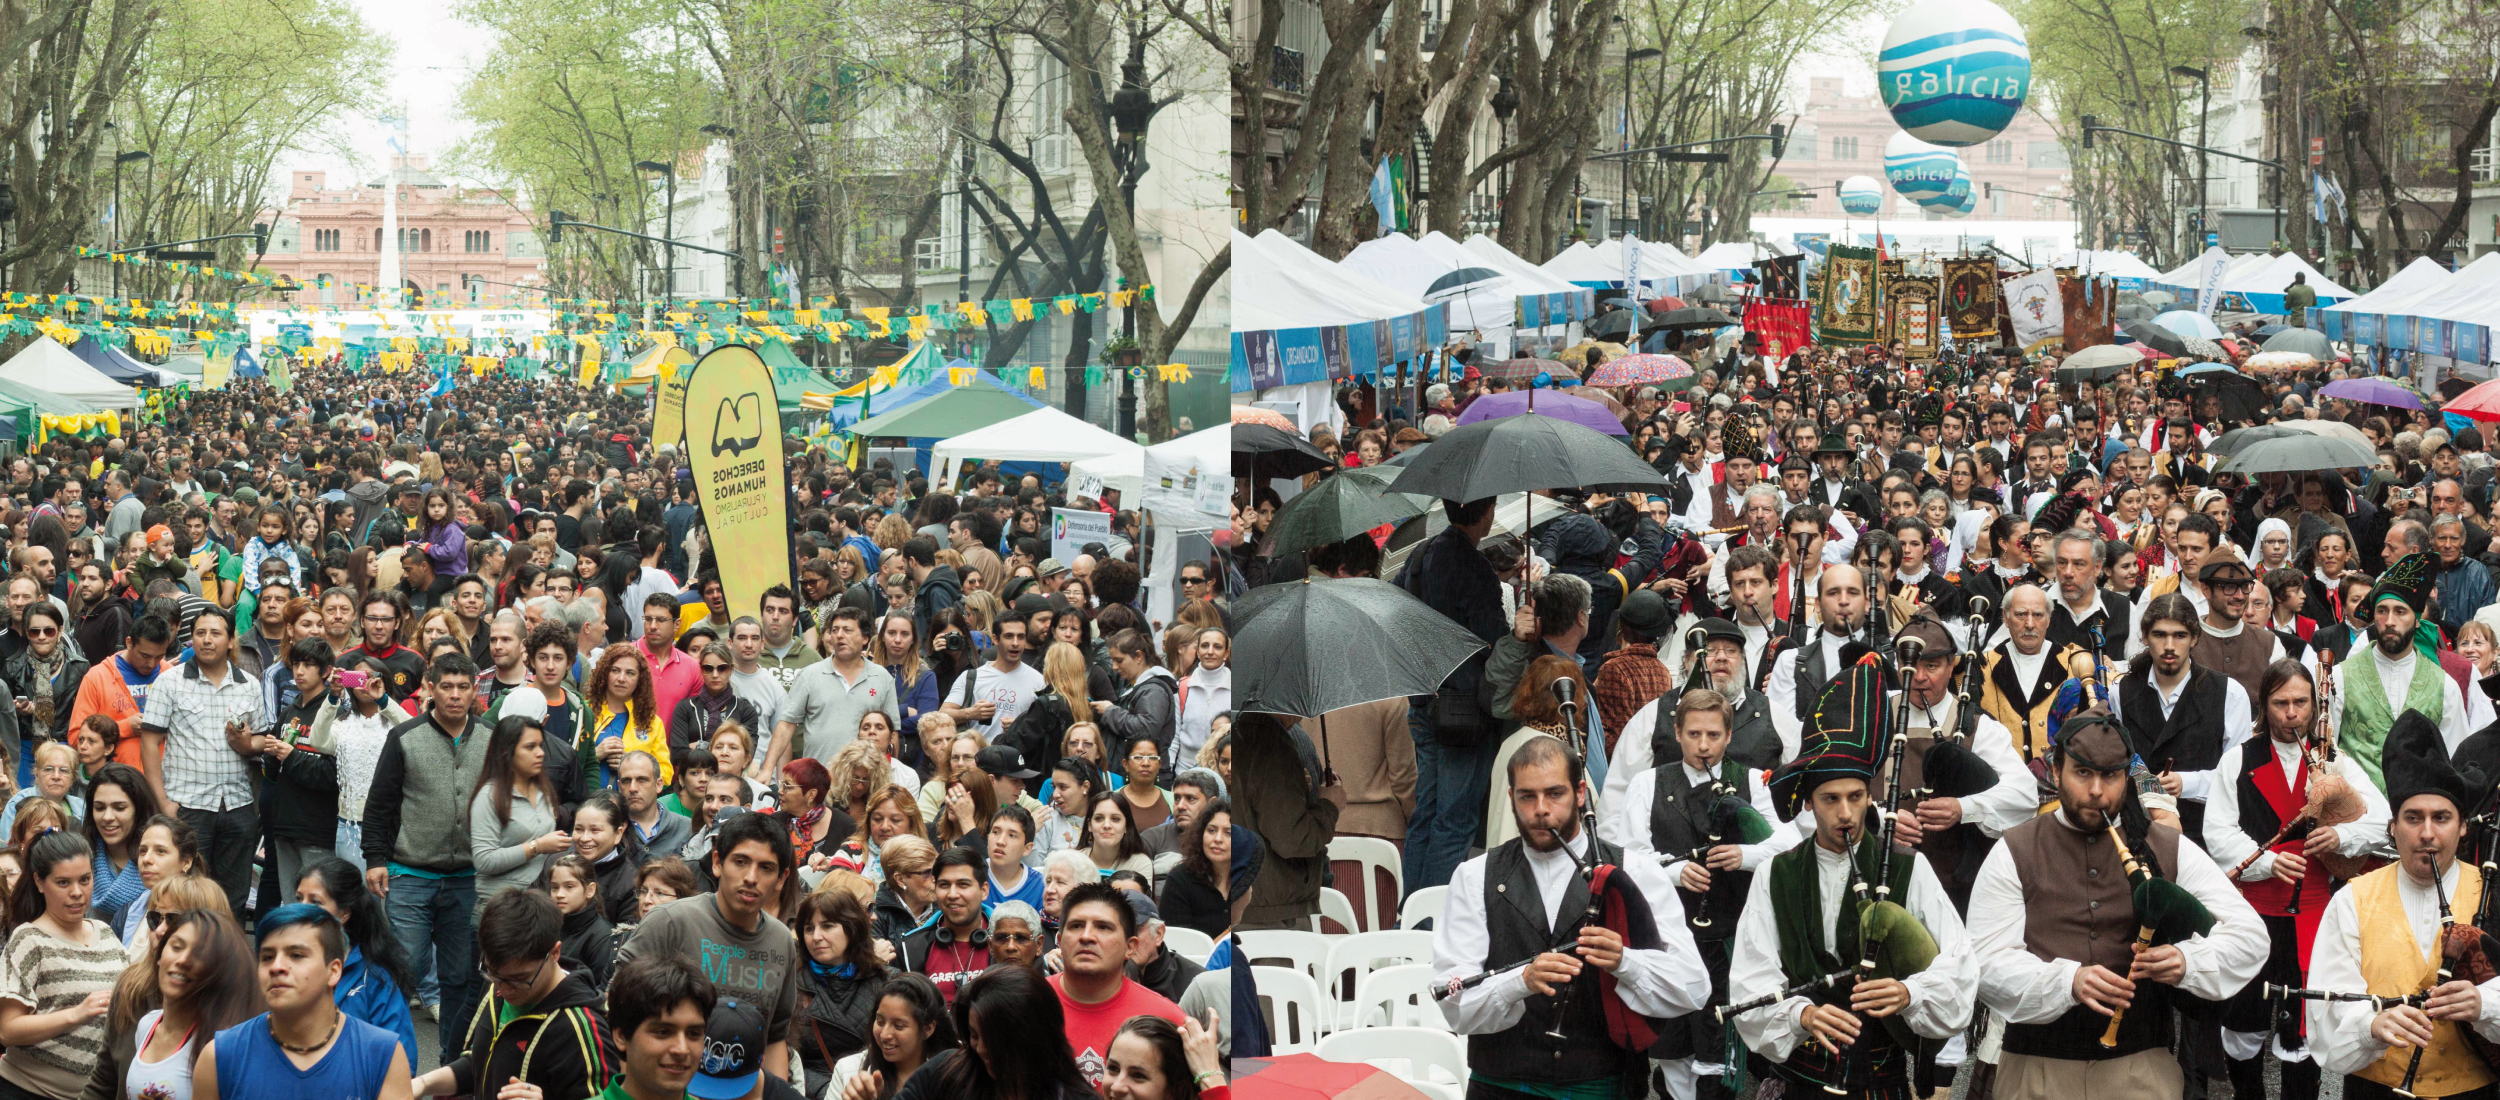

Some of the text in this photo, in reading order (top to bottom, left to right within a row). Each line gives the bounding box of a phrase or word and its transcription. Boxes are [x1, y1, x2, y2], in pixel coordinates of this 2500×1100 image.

[1888, 64, 2020, 110] galicia
[1890, 166, 1954, 185] galicia
[990, 689, 1016, 703] 123
[701, 938, 785, 966] People are like
[702, 1036, 744, 1074] AGIC
